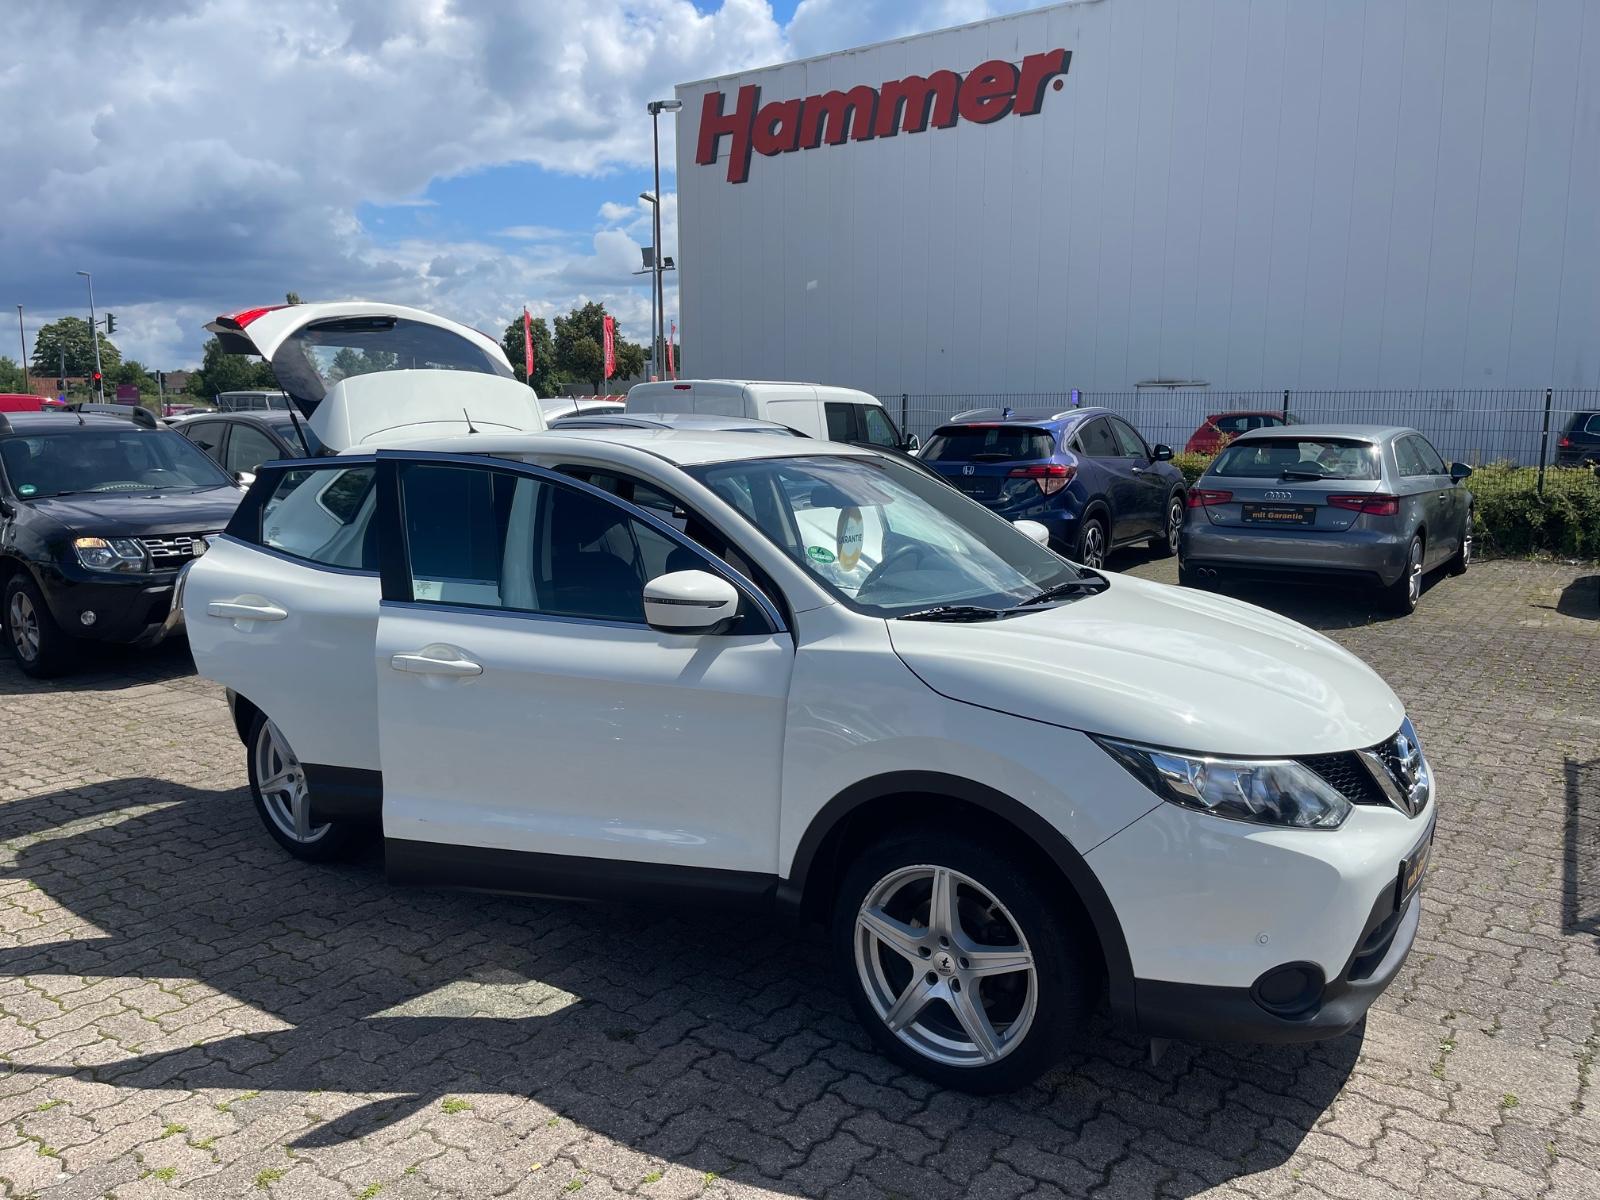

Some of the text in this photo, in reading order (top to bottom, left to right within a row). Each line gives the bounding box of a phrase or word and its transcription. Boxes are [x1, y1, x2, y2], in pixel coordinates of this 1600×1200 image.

[696, 48, 1073, 184] Hammer
[1252, 511, 1304, 520] mit Garantie
